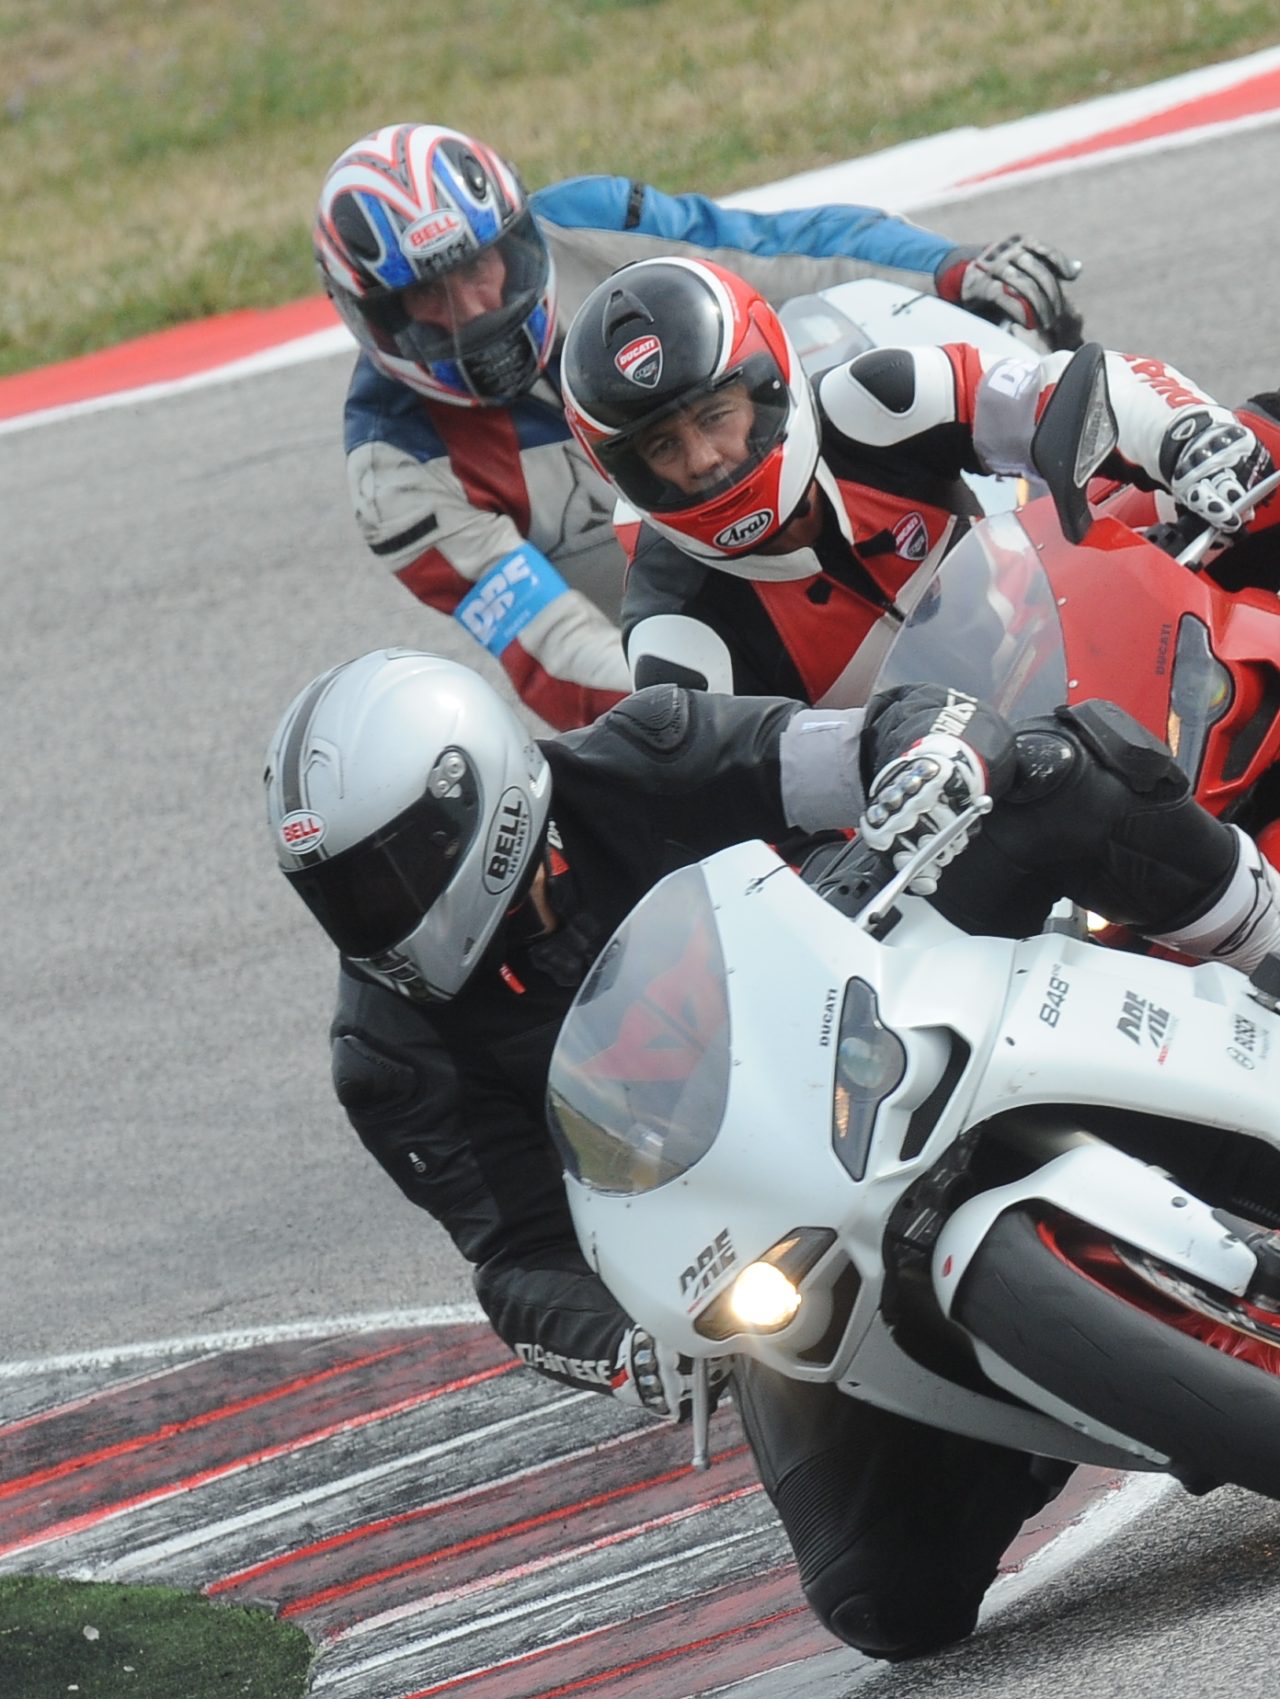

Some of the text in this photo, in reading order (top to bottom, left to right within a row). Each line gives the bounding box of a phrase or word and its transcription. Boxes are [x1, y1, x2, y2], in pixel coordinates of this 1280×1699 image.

[410, 213, 459, 249] BELL
[619, 338, 656, 366] DUCATI
[1155, 623, 1172, 676] DUCATI
[283, 817, 321, 842] BELL
[487, 800, 522, 880] BELL
[819, 988, 837, 1047] DUCATI
